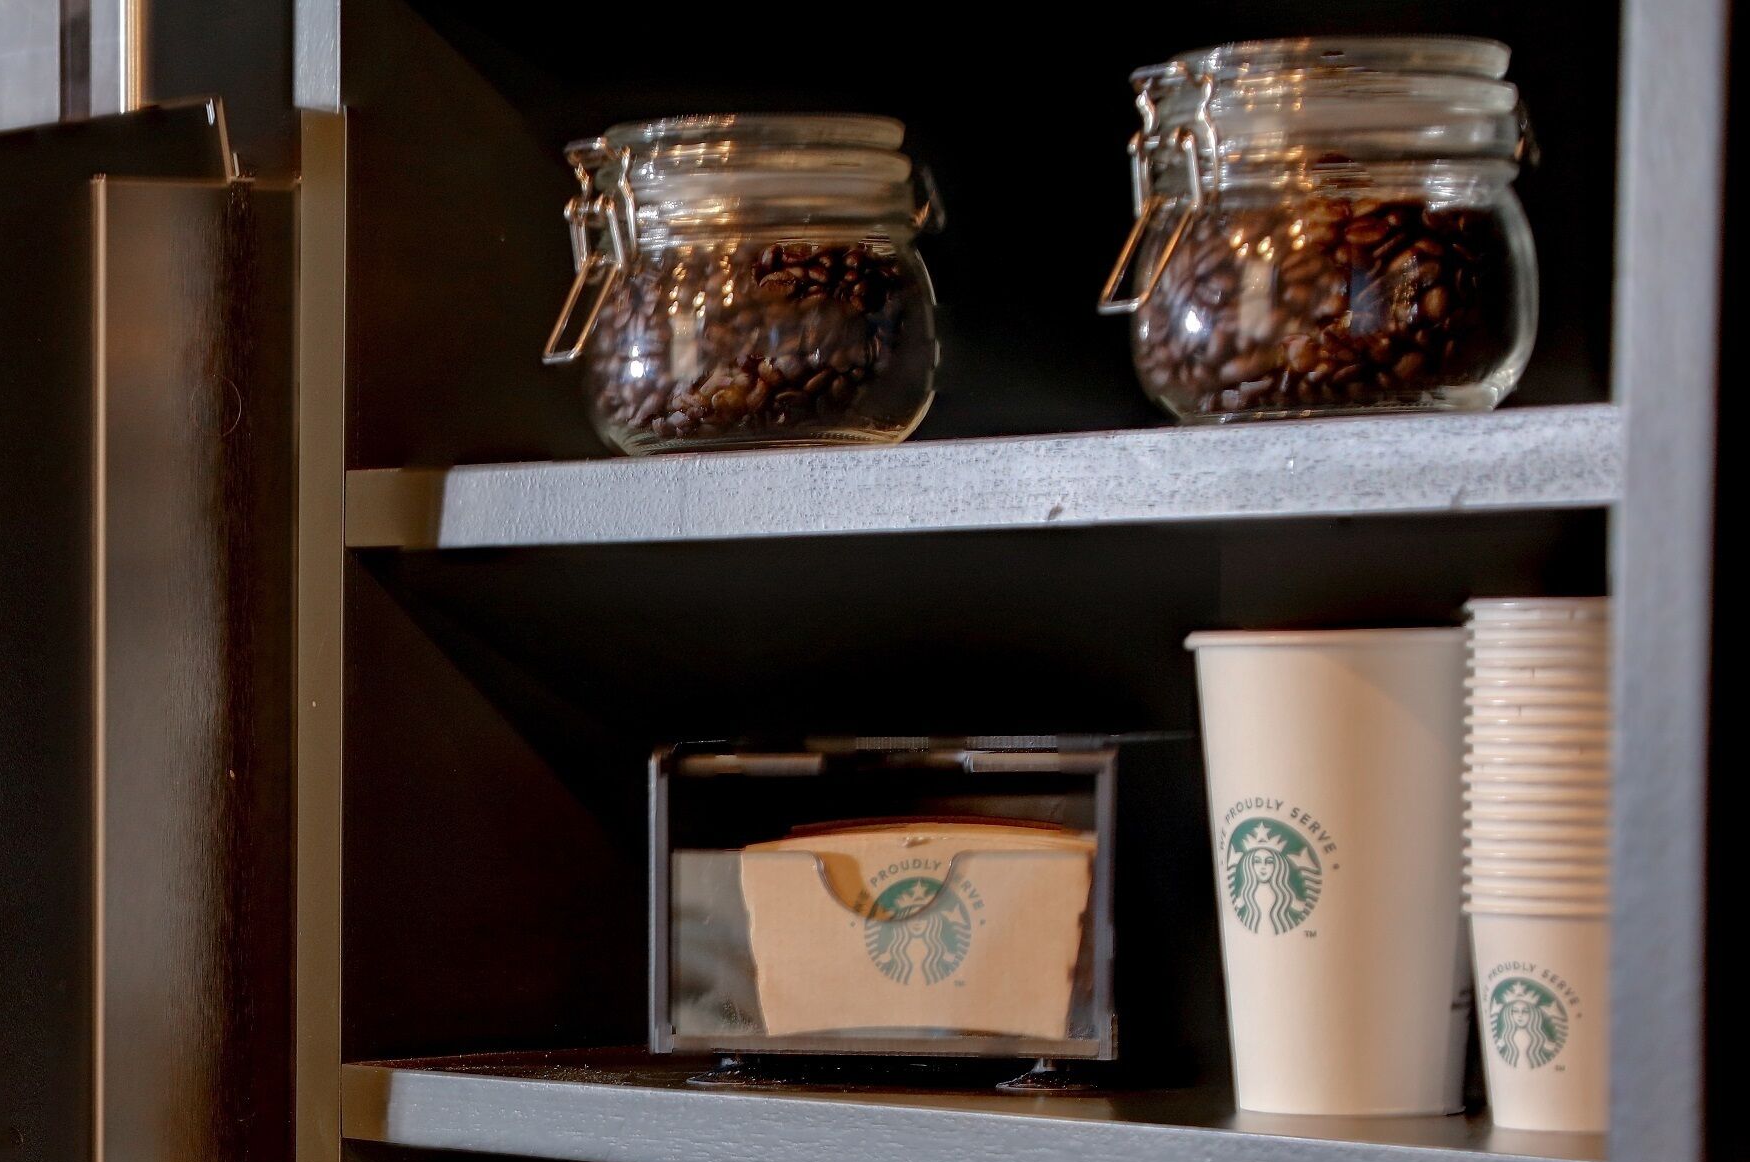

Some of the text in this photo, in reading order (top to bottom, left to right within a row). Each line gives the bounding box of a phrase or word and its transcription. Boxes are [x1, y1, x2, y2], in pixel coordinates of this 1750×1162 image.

[1225, 797, 1284, 824] PROUDLY
[1290, 807, 1337, 854] SERVE
[870, 858, 942, 888] PROUDLY
[1541, 969, 1580, 1006] SERVE
